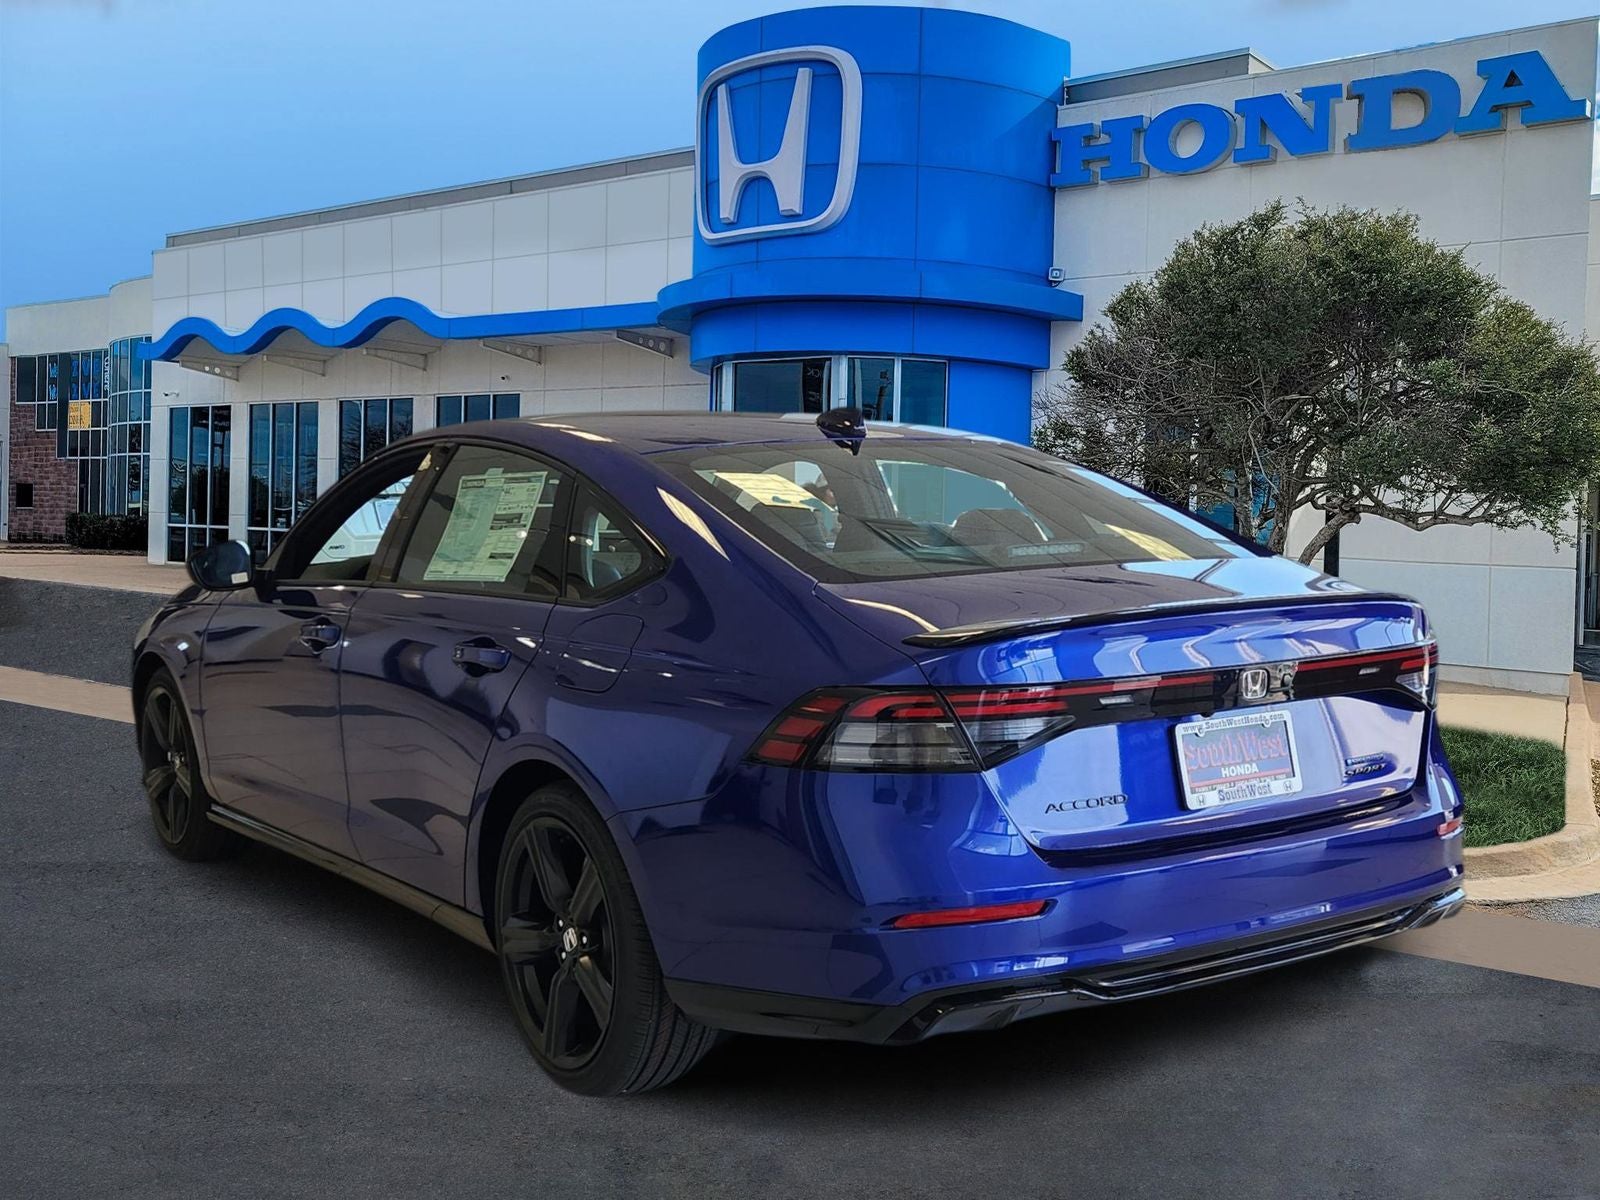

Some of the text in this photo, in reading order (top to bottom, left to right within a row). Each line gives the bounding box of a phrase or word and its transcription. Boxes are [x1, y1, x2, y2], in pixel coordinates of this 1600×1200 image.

[1050, 50, 1591, 188] HONDA
[1221, 762, 1259, 778] HONDA
[1344, 762, 1387, 777] SPORT
[1045, 794, 1127, 814] ACCORD
